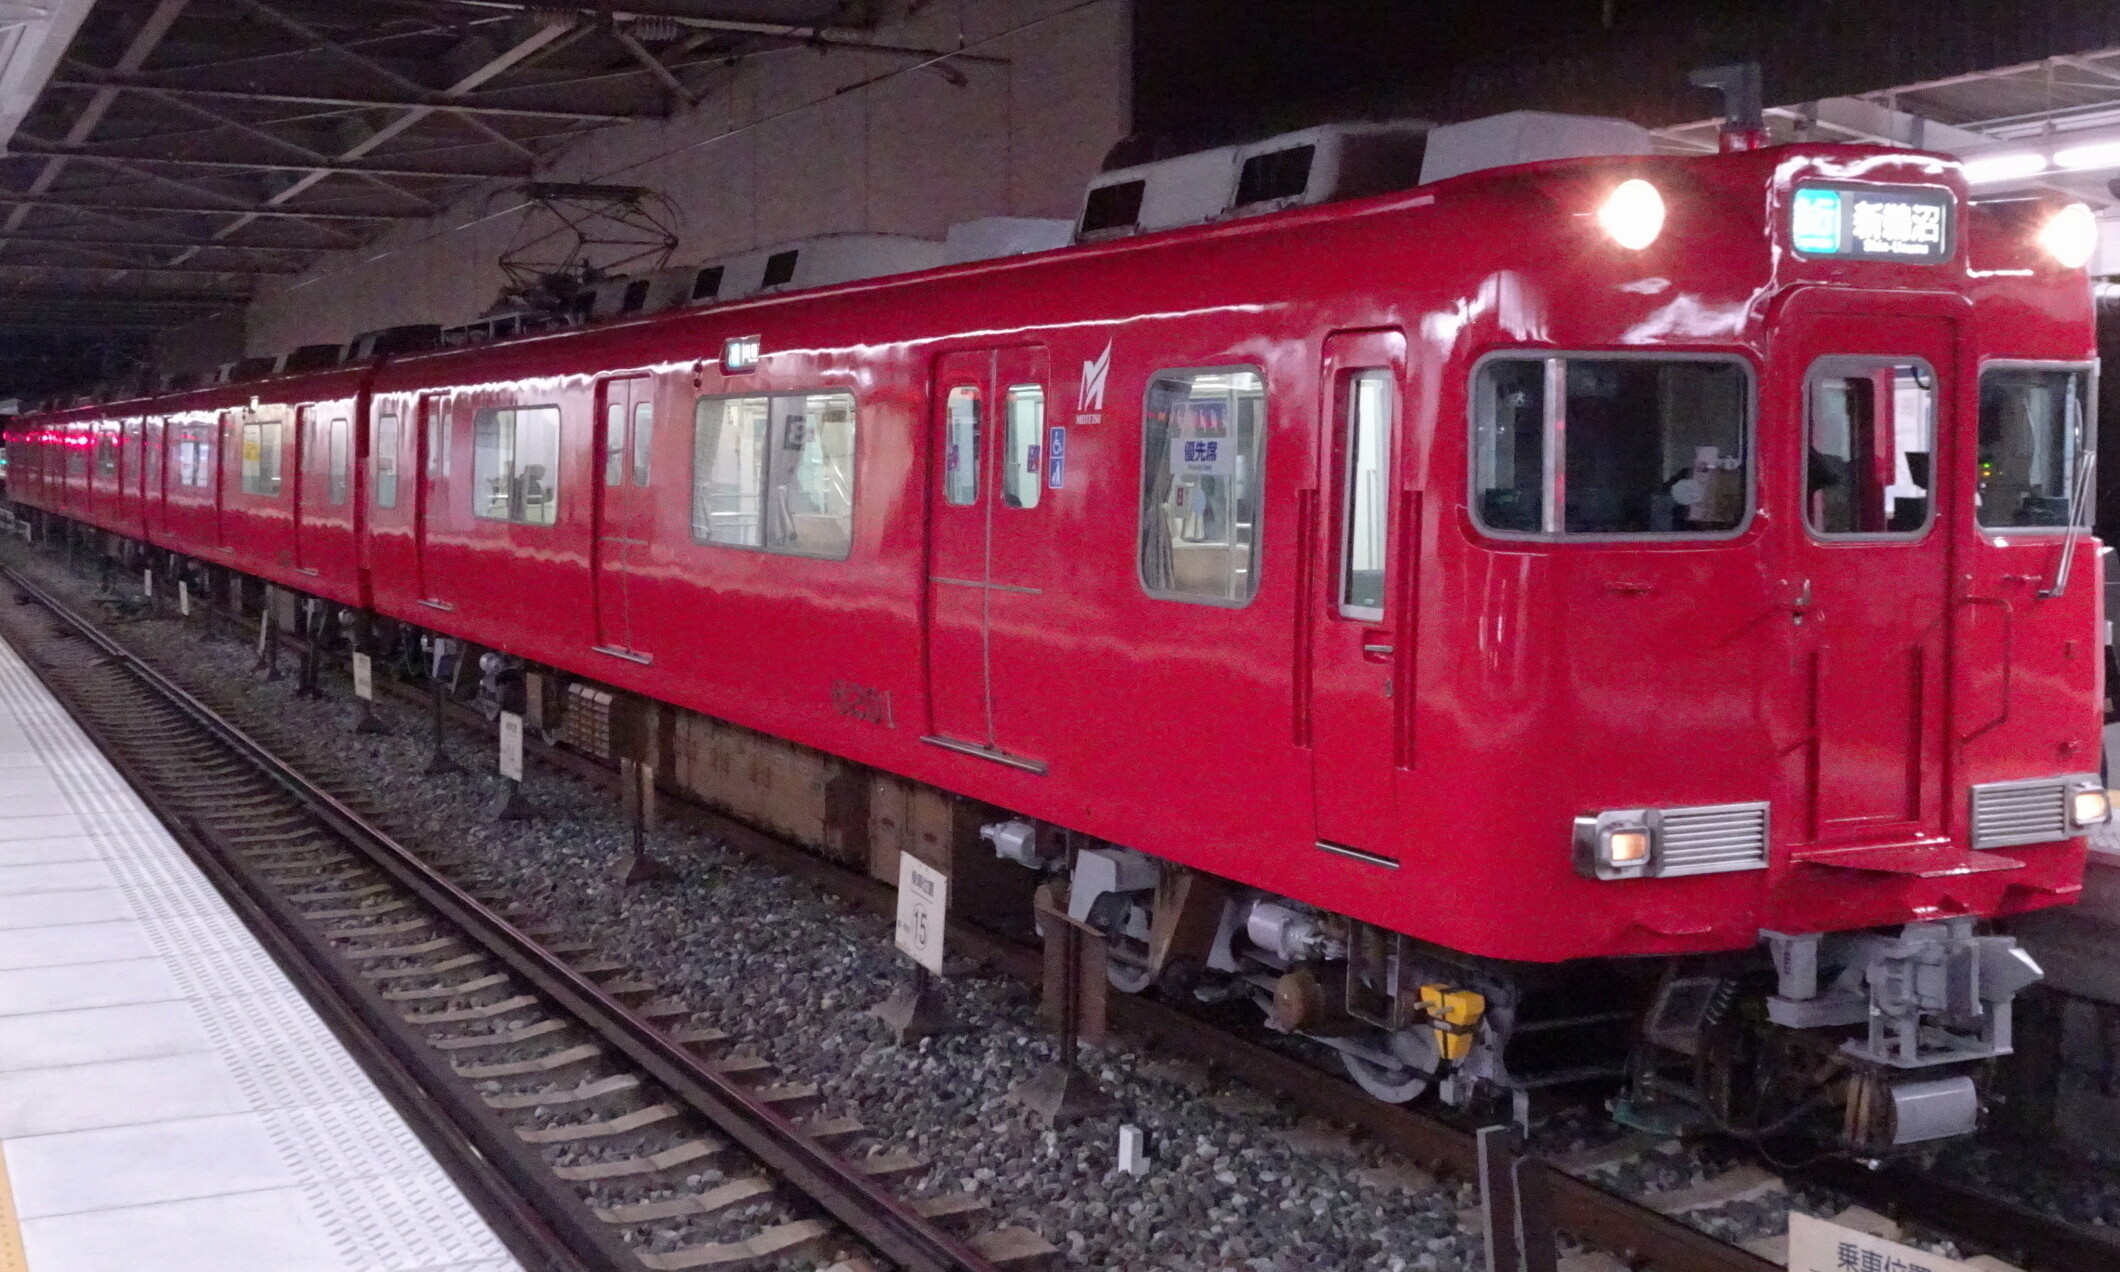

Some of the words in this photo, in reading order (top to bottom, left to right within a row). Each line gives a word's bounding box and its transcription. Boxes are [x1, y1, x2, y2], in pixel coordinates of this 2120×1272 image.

[1184, 441, 1218, 462] 優先席
[914, 908, 928, 945] 15
